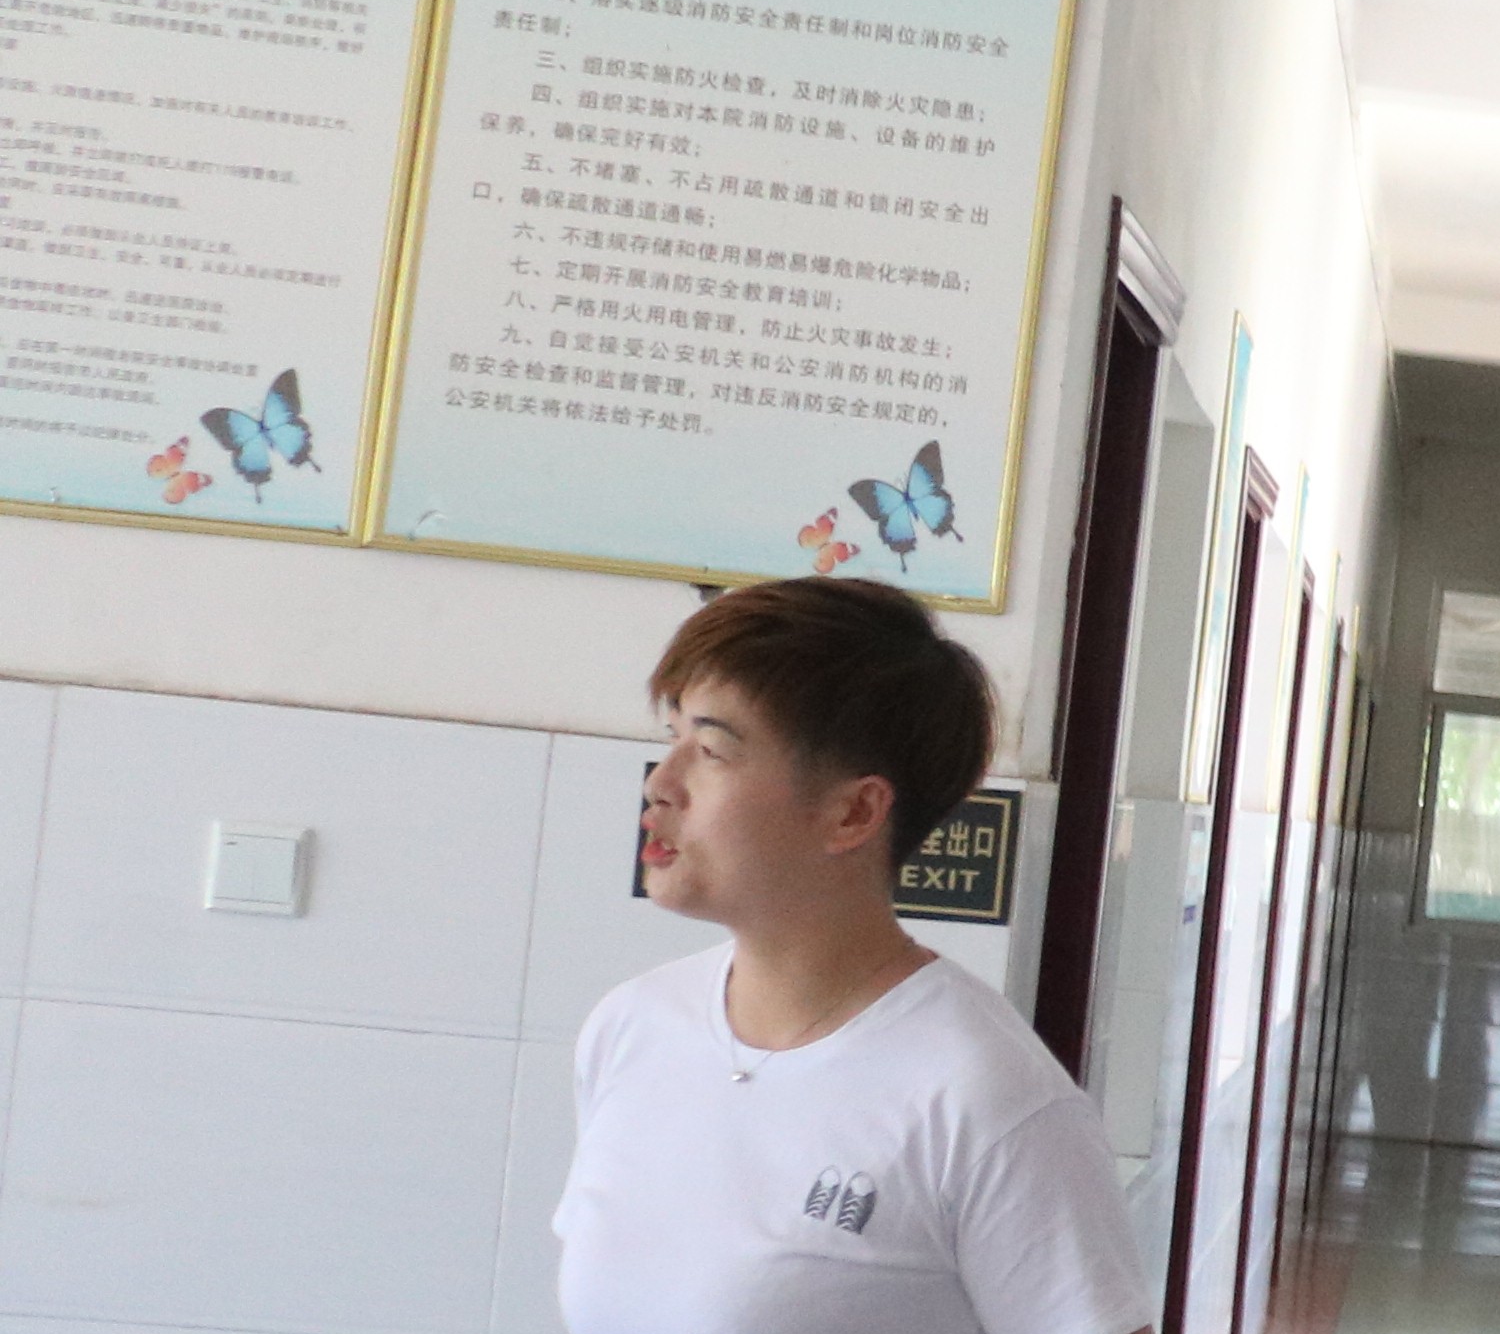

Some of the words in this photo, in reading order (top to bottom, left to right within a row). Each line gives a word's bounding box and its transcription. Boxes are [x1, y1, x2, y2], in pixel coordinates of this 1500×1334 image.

[921, 820, 996, 858] 全出口
[901, 865, 980, 893] EXIT
